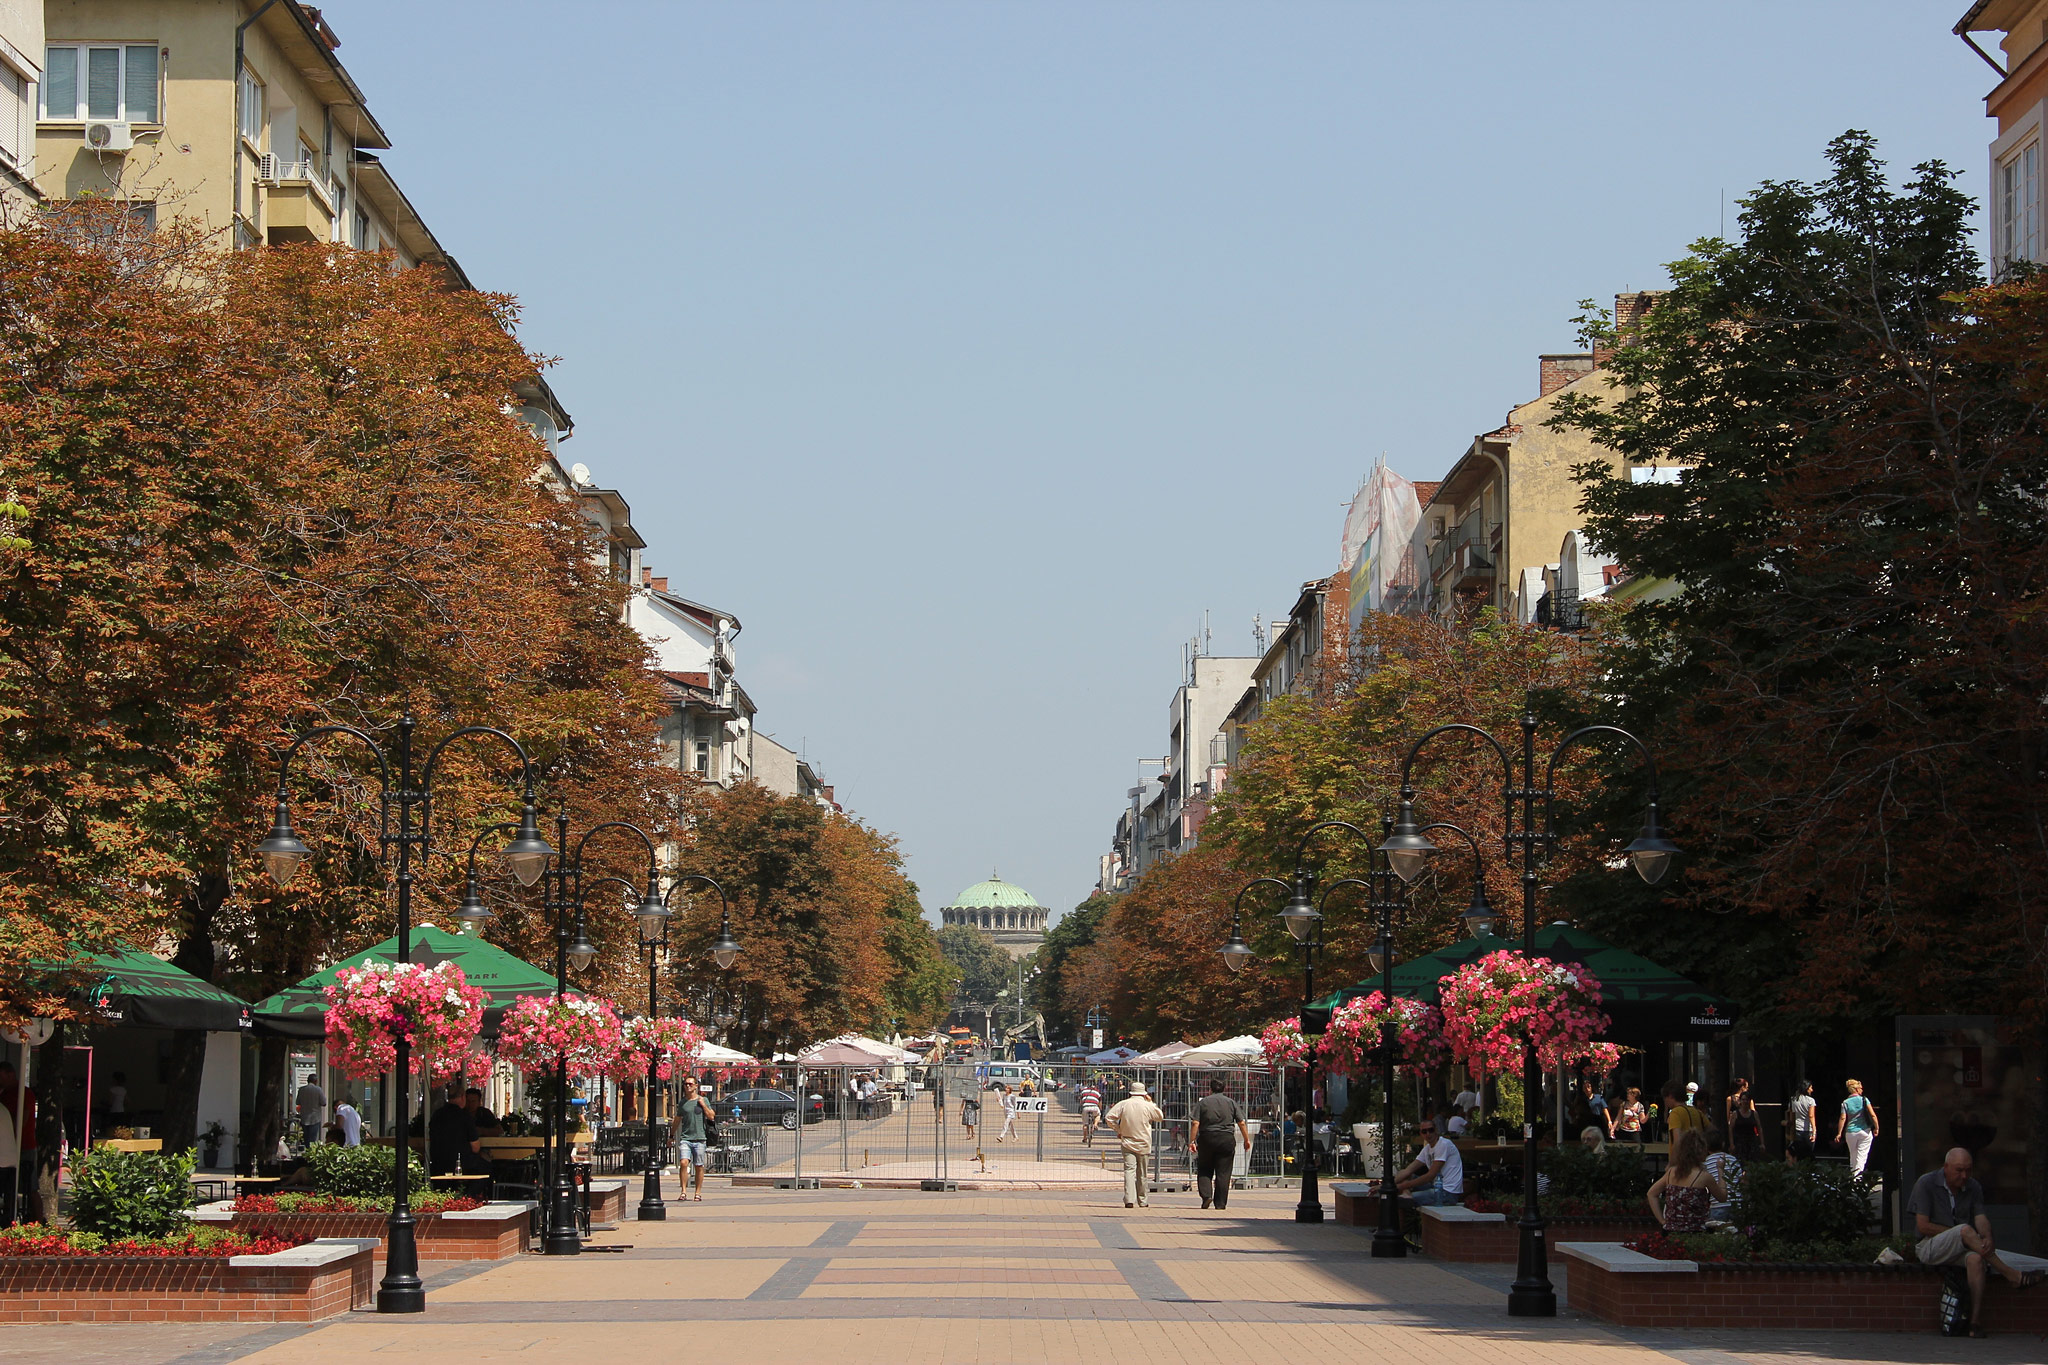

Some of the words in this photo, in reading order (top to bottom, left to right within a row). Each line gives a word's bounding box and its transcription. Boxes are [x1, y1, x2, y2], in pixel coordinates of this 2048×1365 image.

[465, 972, 499, 980] MARK
[1690, 1016, 1731, 1026] Heineken
[1016, 1098, 1046, 1111] TRACE
